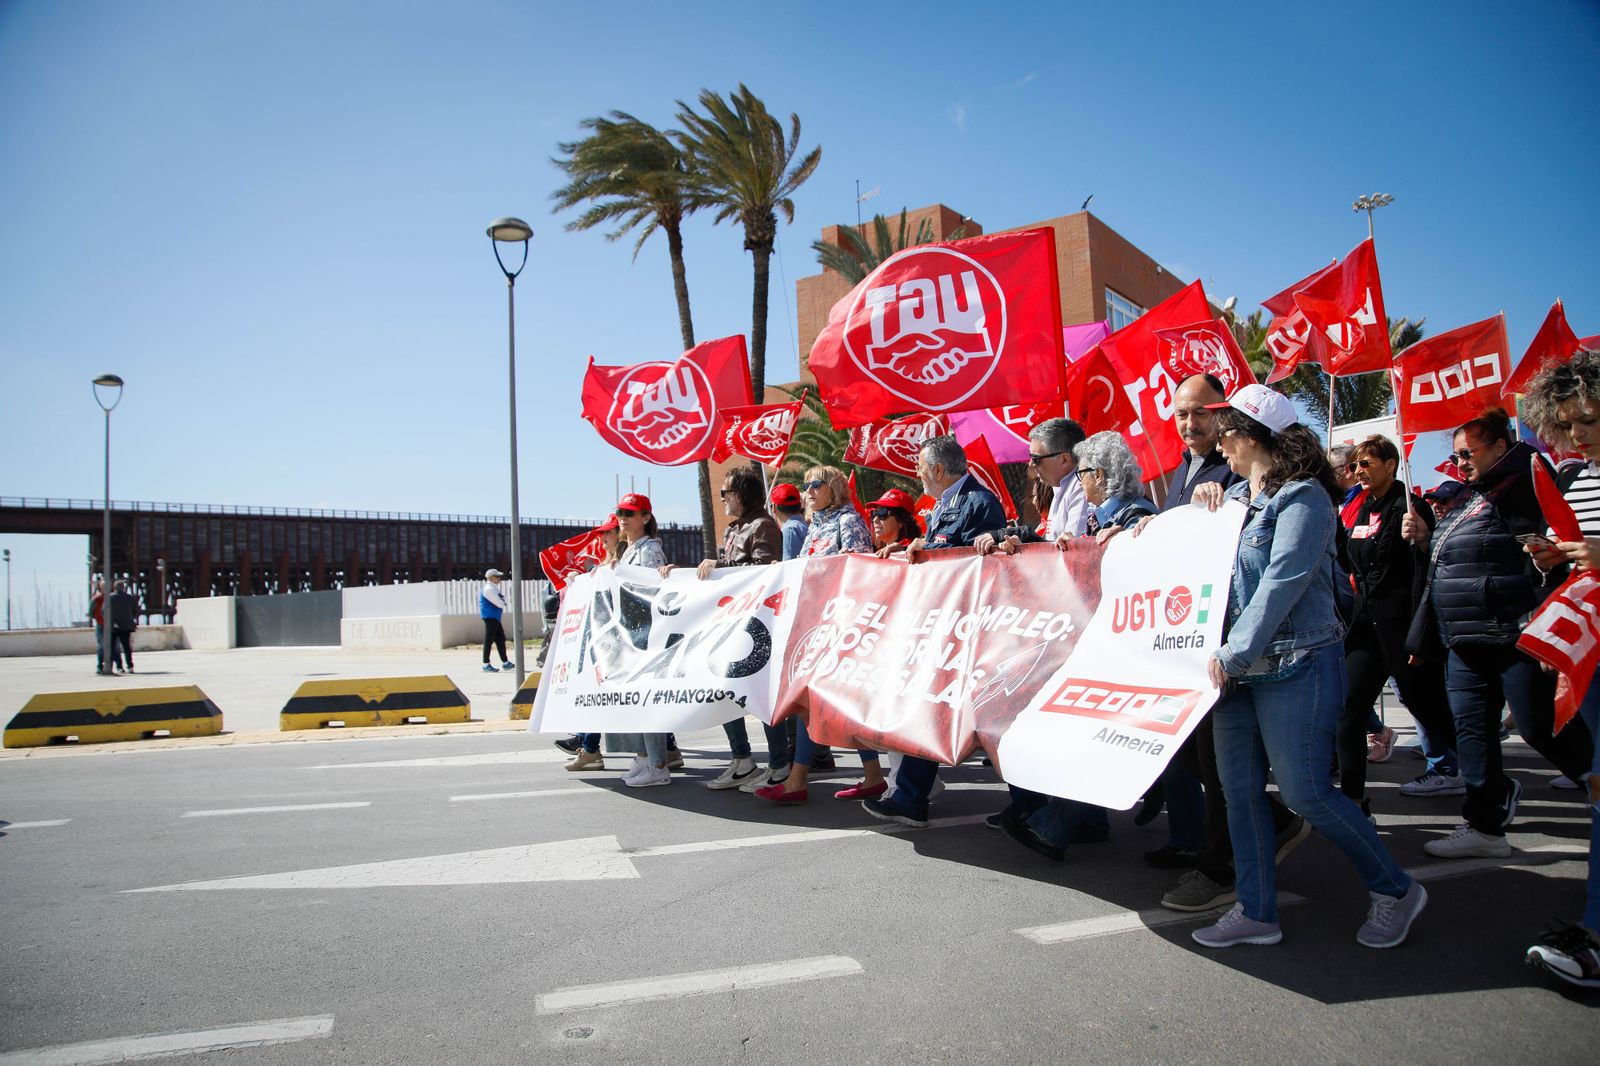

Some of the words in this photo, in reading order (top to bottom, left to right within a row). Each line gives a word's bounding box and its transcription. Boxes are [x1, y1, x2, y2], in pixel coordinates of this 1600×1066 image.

[854, 601, 888, 631] EL
[1112, 589, 1161, 634] UGT
[807, 624, 880, 657] ENOS
[1153, 629, 1204, 651] Almería
[574, 691, 640, 707] #PLENOEMPLEO
[1052, 686, 1153, 717] CCOO
[1091, 726, 1165, 756] Almería
